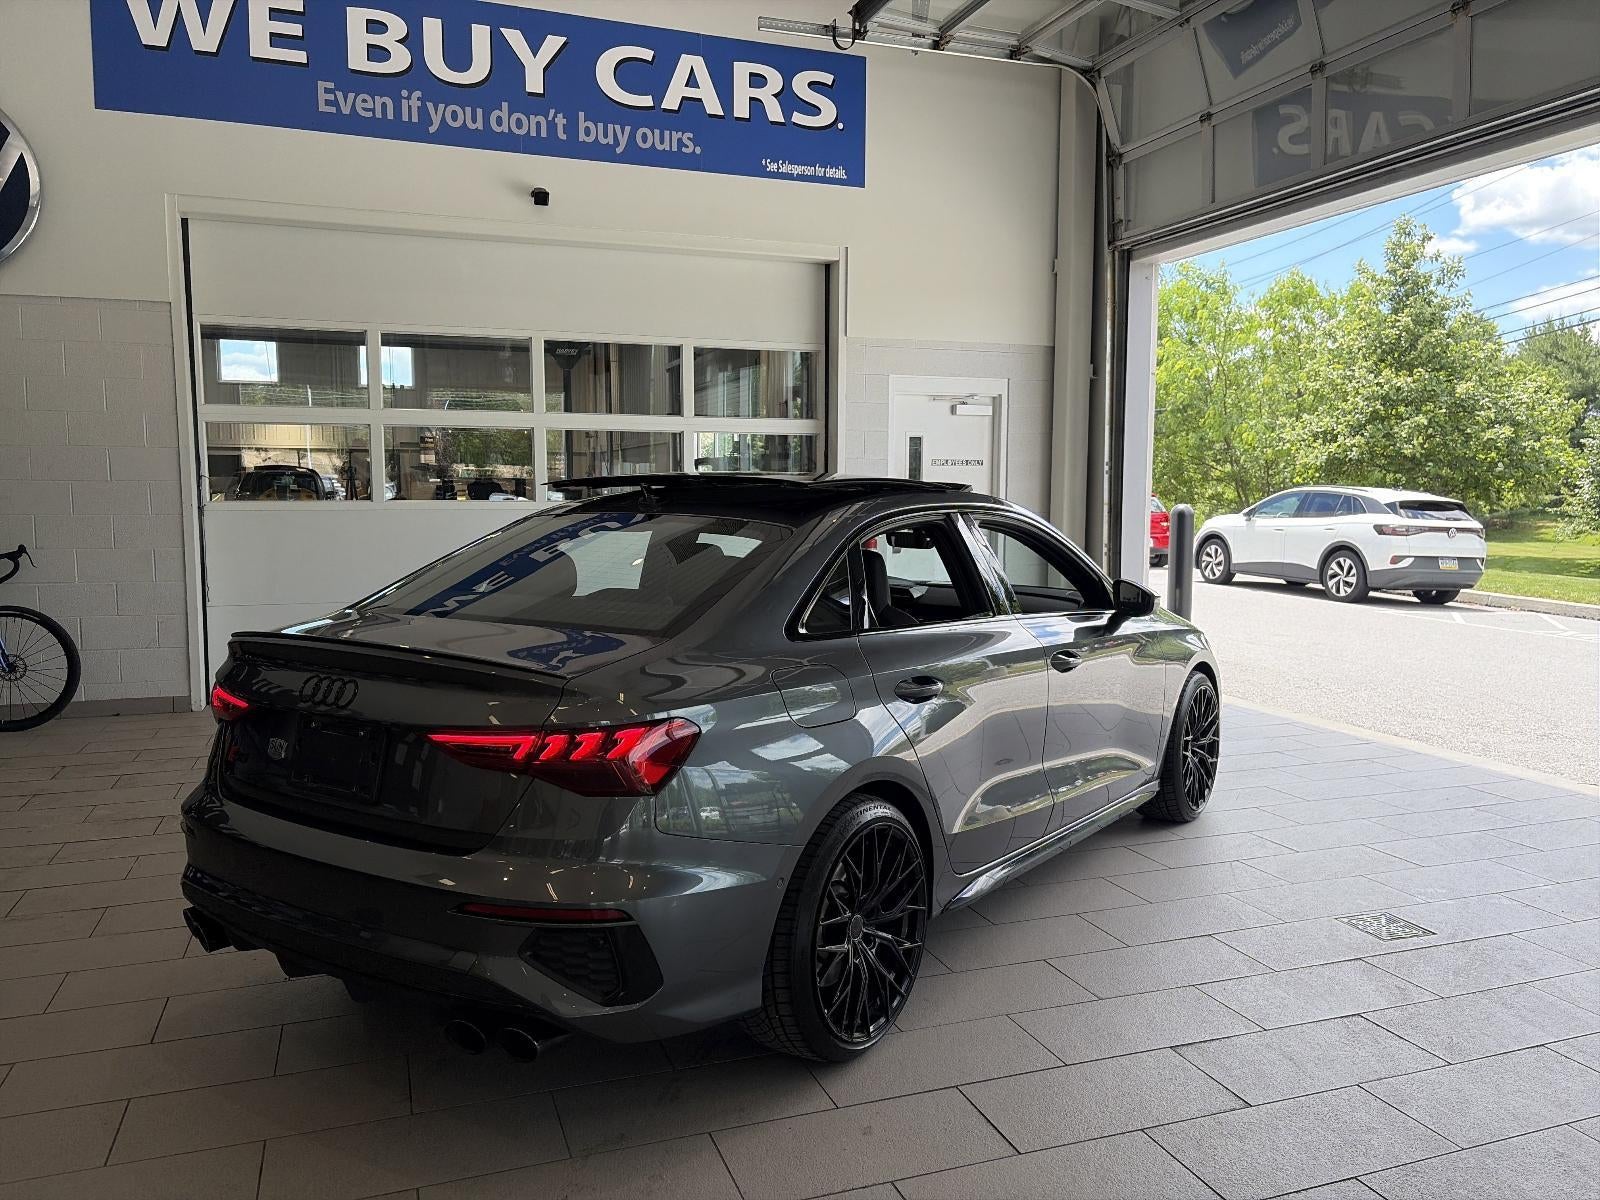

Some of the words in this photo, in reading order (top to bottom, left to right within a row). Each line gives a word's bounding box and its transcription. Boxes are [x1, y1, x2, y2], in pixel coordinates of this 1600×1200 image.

[126, 0, 309, 65] WE
[346, 7, 568, 96] BUY
[596, 46, 844, 131] CARS.
[318, 81, 394, 120] Even
[401, 89, 422, 123] if
[426, 102, 484, 134] you
[489, 101, 567, 140] don't
[578, 112, 632, 154] buy
[636, 128, 702, 155] ours.
[766, 158, 778, 173] See
[779, 160, 814, 177] Salesperson
[815, 163, 826, 177] for
[826, 164, 847, 179] details.
